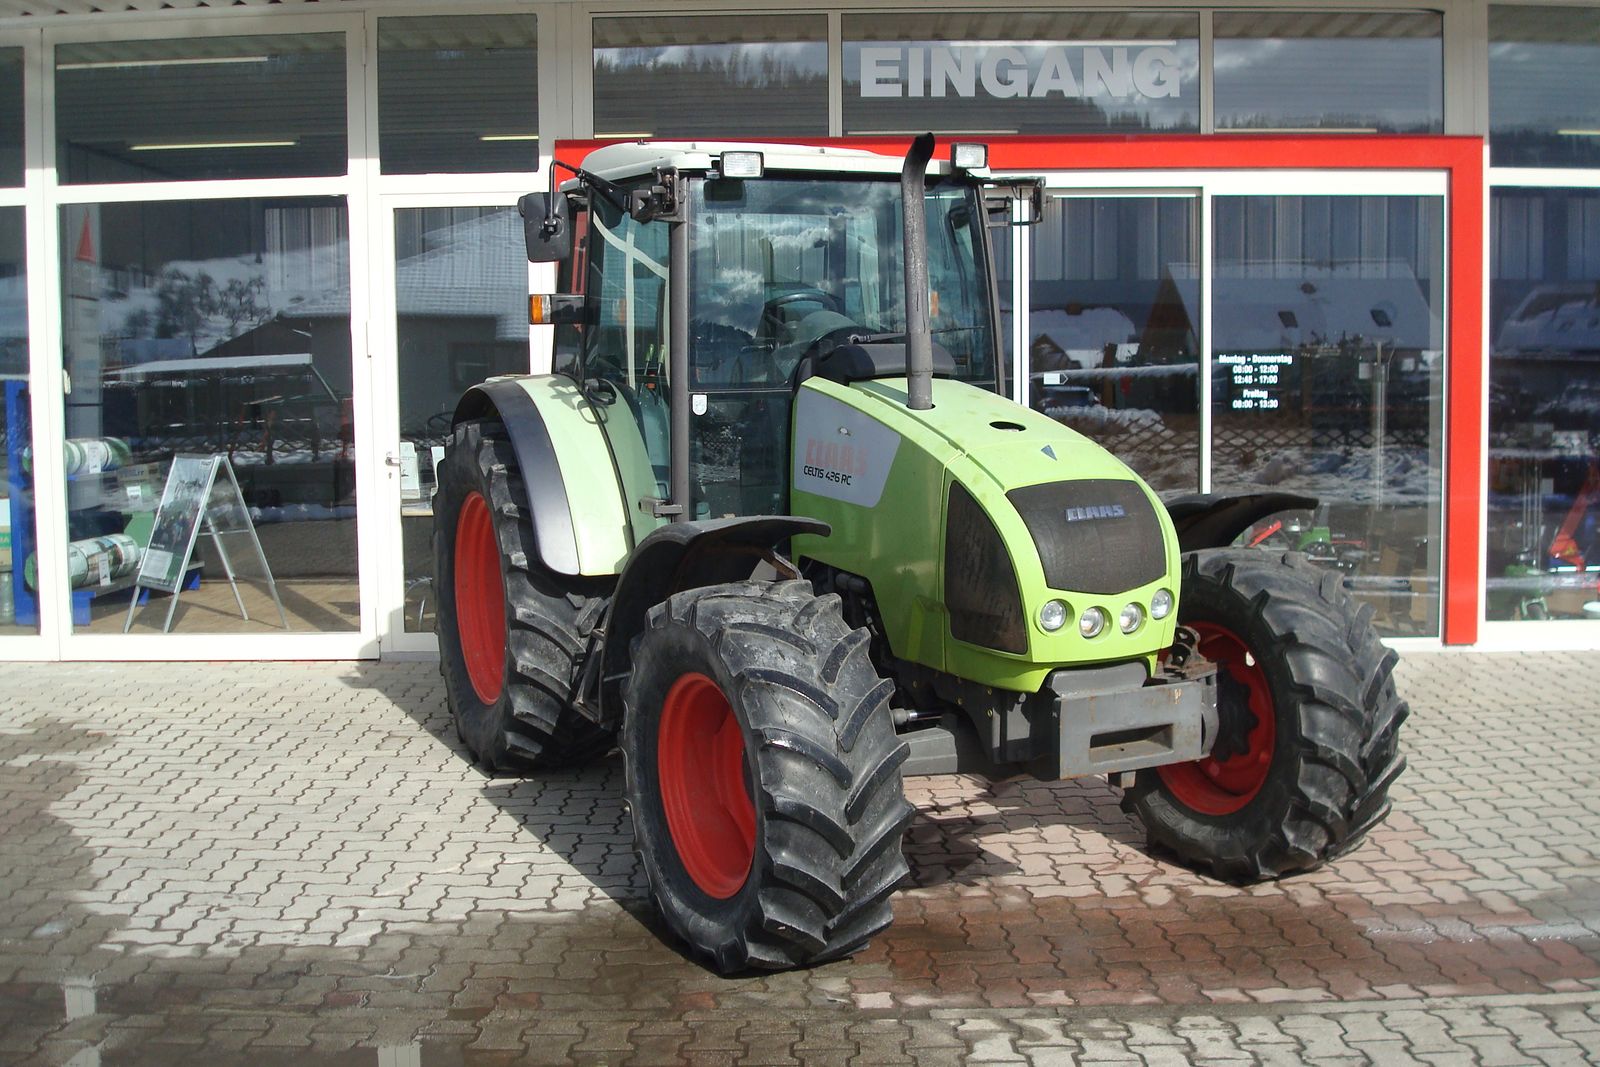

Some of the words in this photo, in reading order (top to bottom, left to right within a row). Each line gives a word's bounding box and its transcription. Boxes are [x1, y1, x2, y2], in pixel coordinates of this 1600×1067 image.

[860, 46, 1181, 98] EINGANG
[1219, 354, 1246, 364] Montag
[1252, 354, 1293, 364] Donnerstag
[1259, 365, 1279, 374] 12:00
[1259, 375, 1278, 384] 17:00
[1243, 389, 1268, 399] Freitag
[803, 465, 825, 479] CELTIS
[1065, 504, 1124, 522] CLAAS
